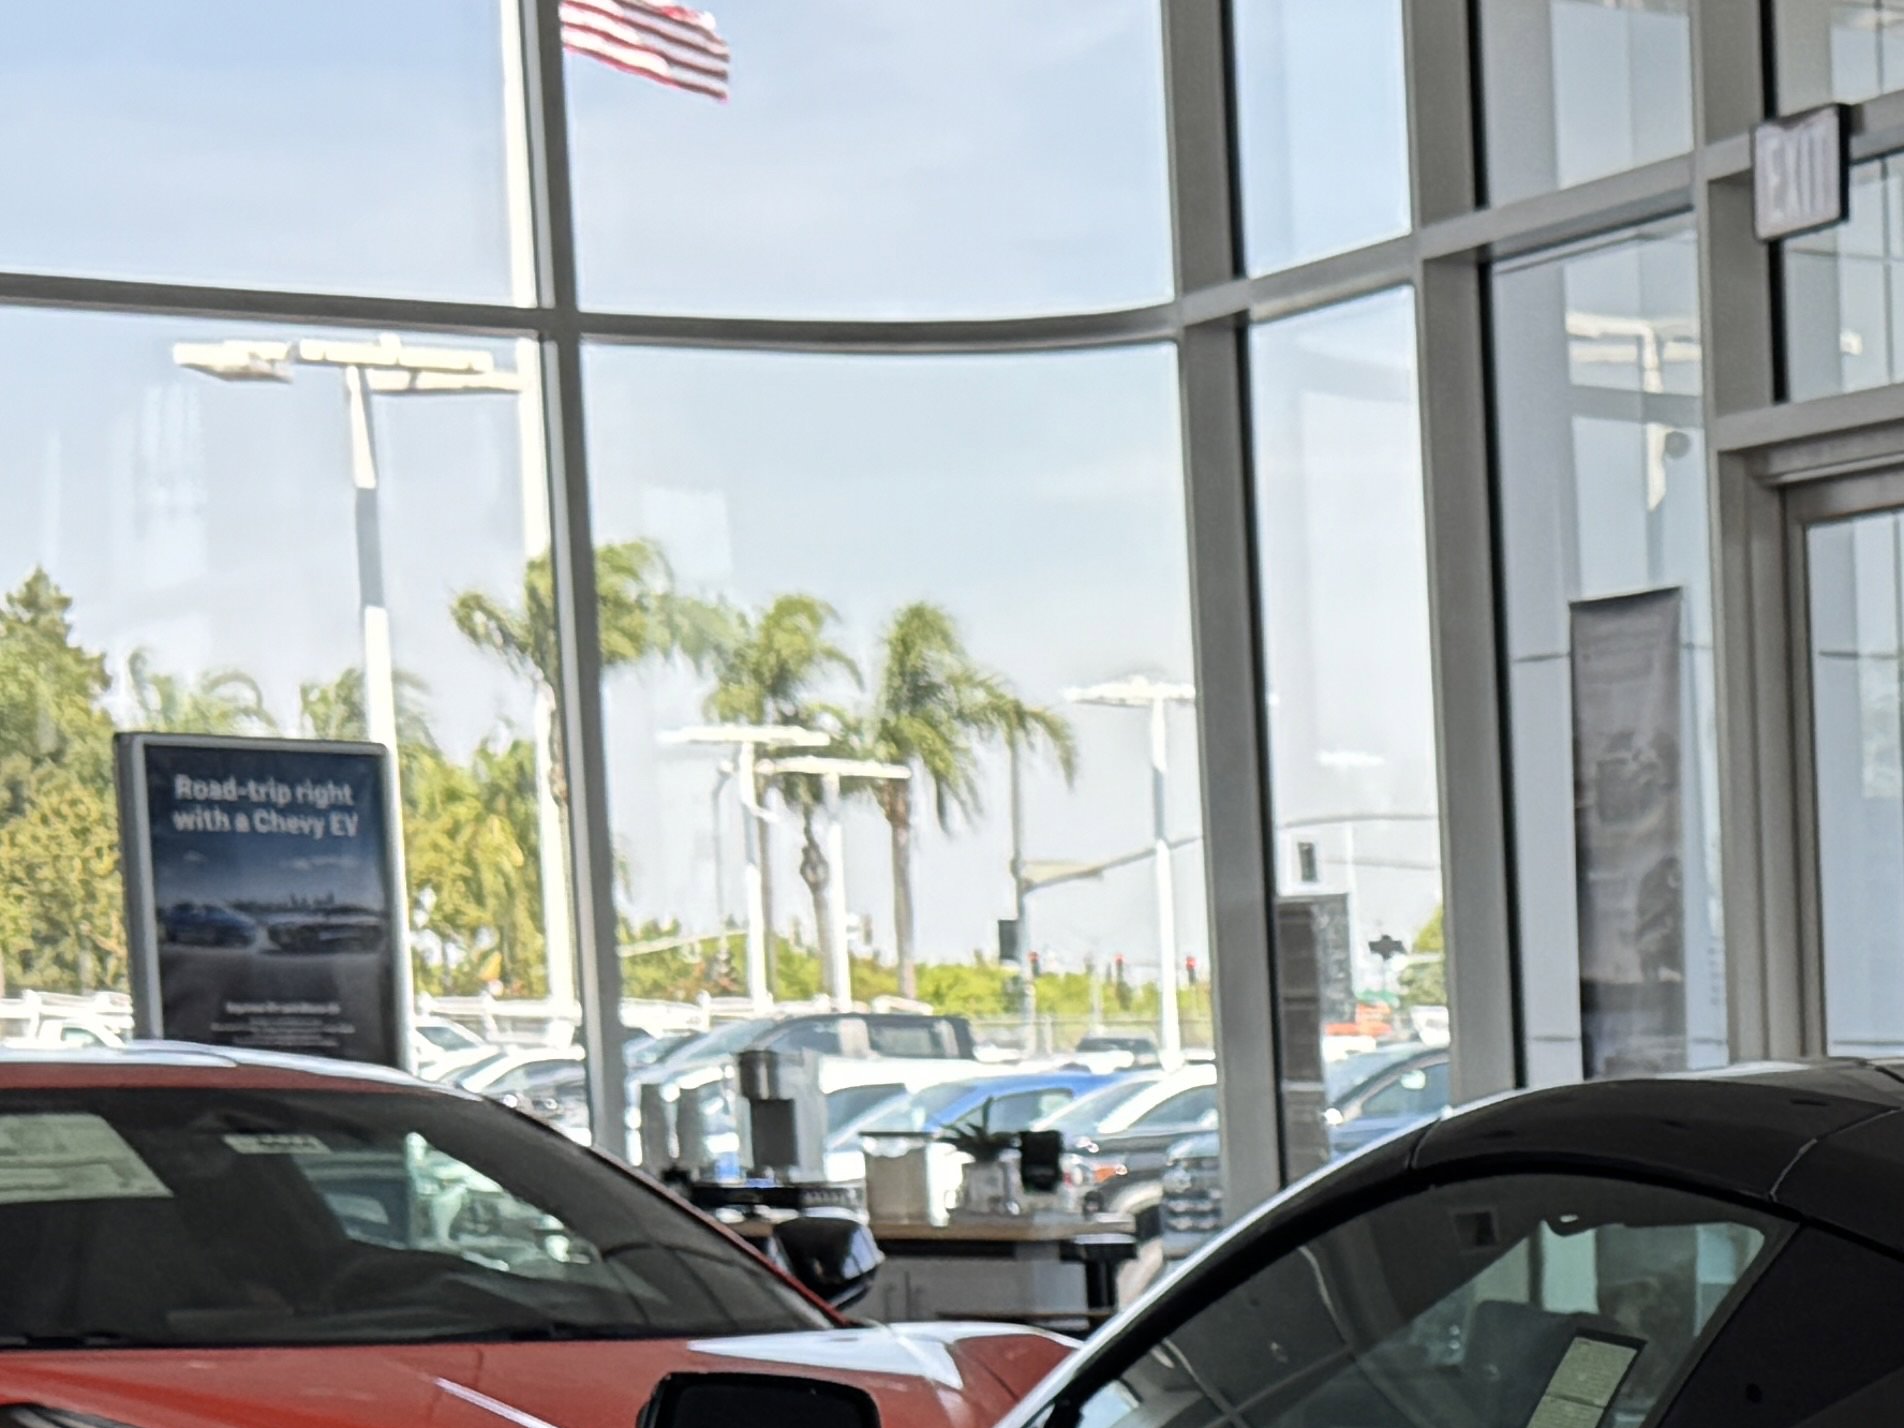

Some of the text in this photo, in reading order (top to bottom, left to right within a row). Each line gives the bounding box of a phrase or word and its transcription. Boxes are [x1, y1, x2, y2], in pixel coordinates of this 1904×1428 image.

[174, 773, 354, 809] Road-trip right
[173, 806, 359, 840] with a Chevy EV
